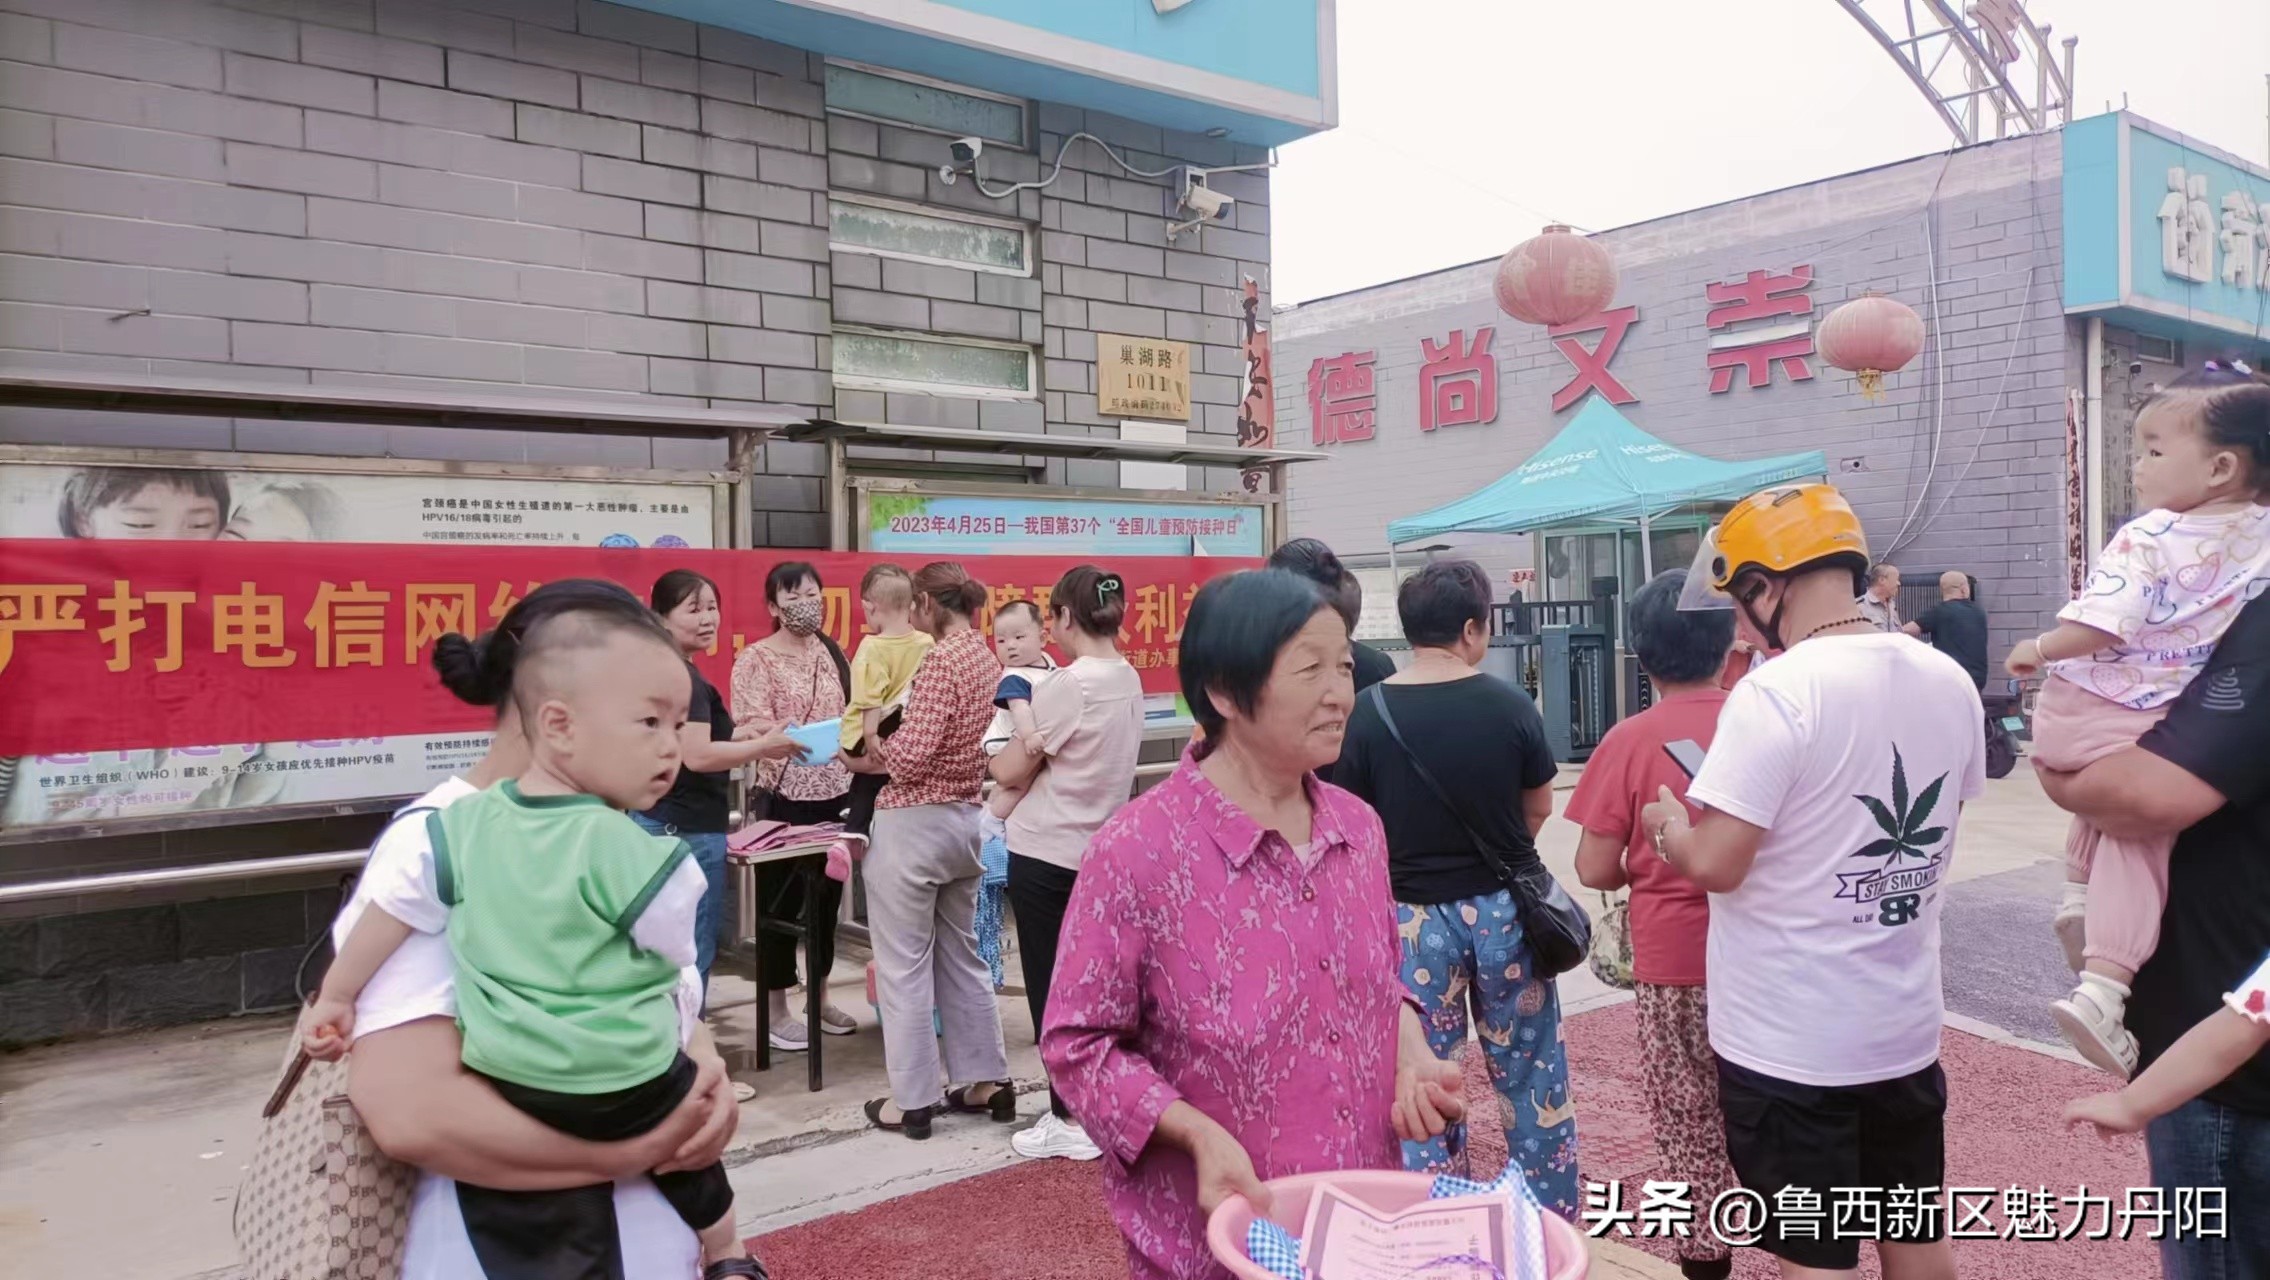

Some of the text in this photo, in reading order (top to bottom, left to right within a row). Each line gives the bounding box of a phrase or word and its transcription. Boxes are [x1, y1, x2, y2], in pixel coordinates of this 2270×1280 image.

[1120, 345, 1172, 369] 巢湖路
[1127, 373, 1167, 392] 1011
[1518, 449, 1599, 475] Hisense
[422, 511, 523, 525] HPV16/18病毒引起的
[425, 738, 496, 751] 有效预防持续感
[1864, 877, 1889, 898] STAY
